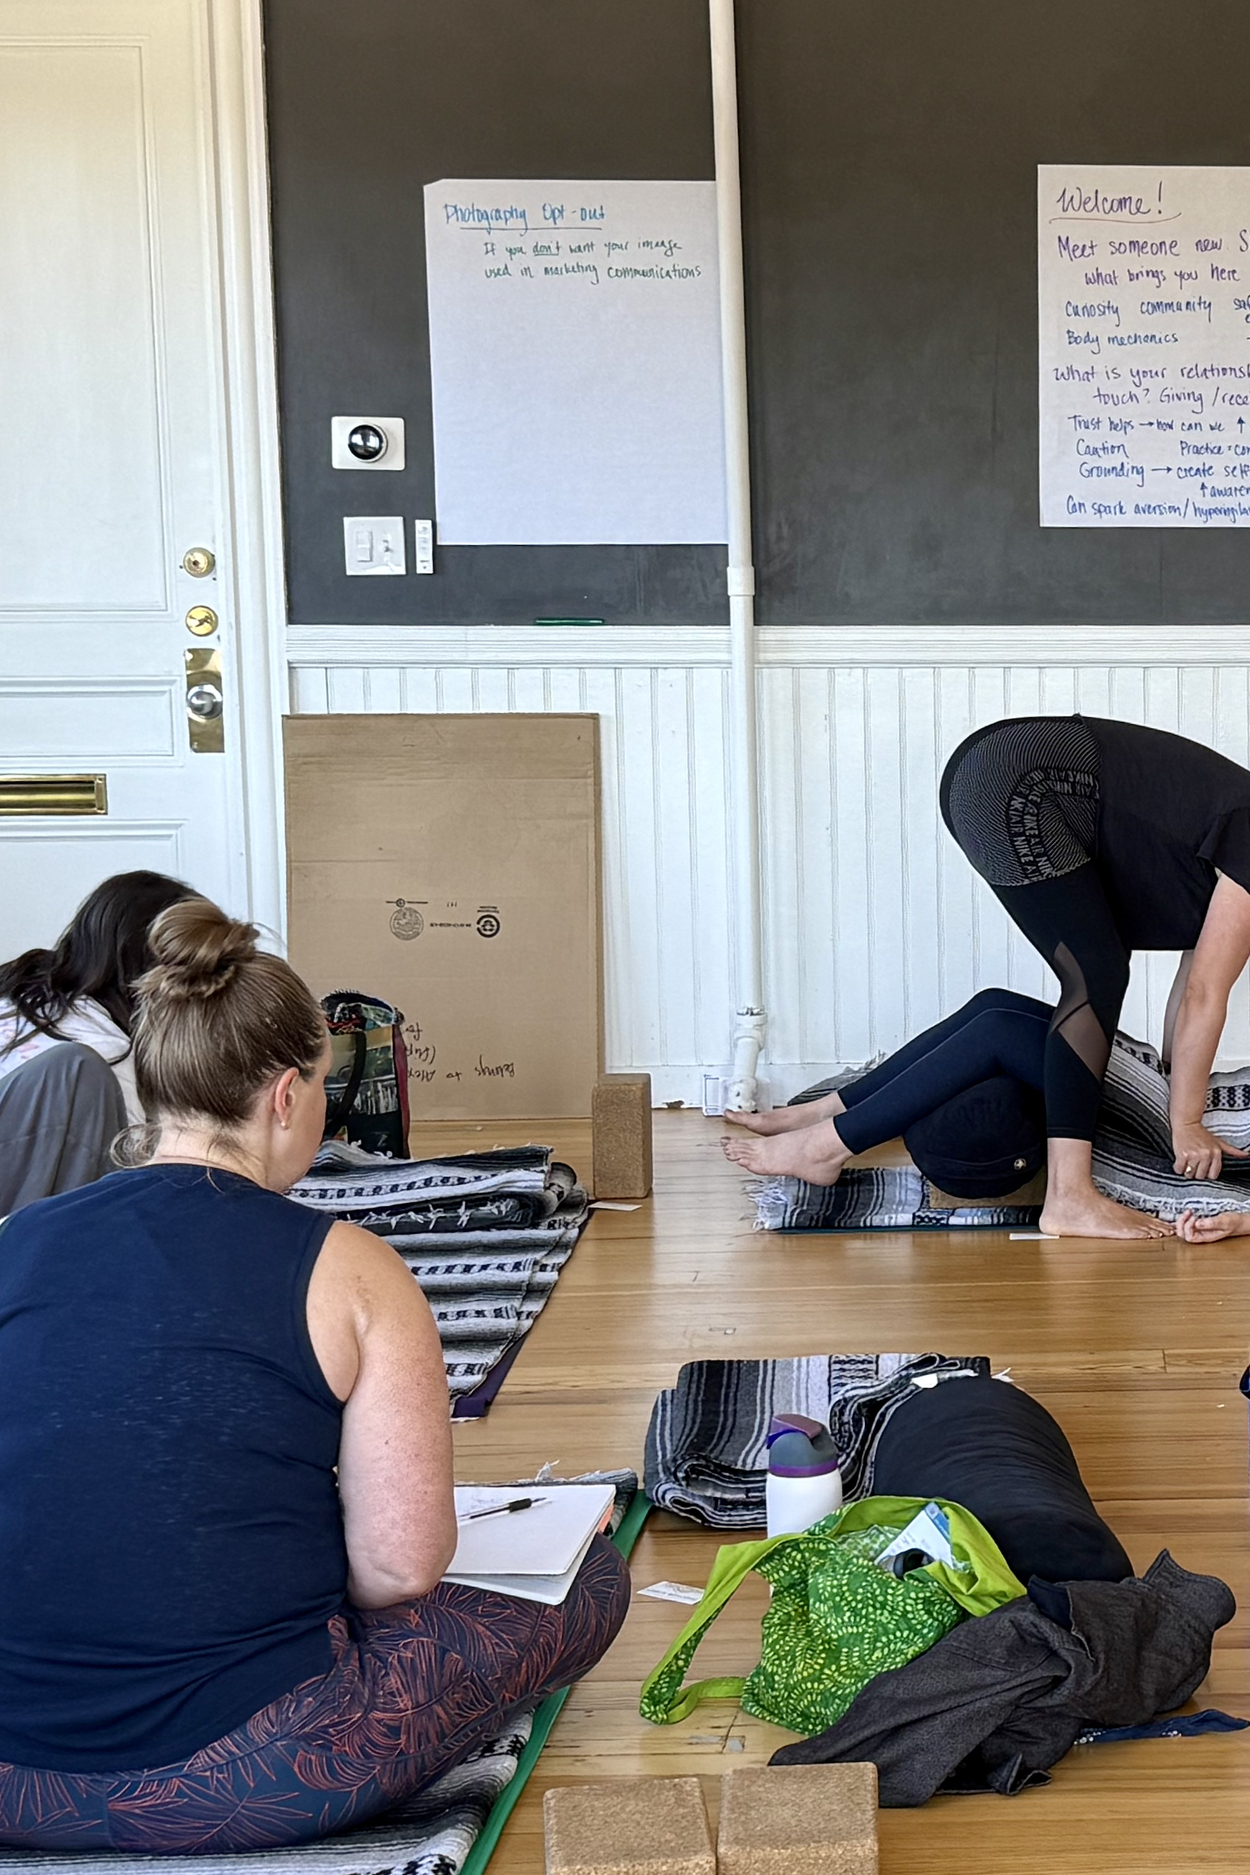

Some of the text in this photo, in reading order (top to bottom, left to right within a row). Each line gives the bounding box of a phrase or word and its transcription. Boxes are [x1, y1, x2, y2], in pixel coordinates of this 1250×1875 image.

[1056, 180, 1163, 215] Welcome!
[443, 203, 527, 236] Photography
[505, 246, 526, 261] you
[569, 241, 595, 254] want
[604, 241, 629, 258] your
[1057, 235, 1098, 262] Meet
[1109, 238, 1181, 257] someone
[484, 261, 702, 285] used in marketing communications
[1128, 265, 1166, 289] brings
[1174, 270, 1198, 290] you
[1210, 263, 1241, 281] here
[1065, 299, 1121, 327] Curiosity
[1140, 296, 1212, 322] community
[1066, 329, 1179, 355] Body mechanics
[1053, 364, 1098, 382] What
[1104, 366, 1121, 379] is
[1130, 367, 1168, 387] your
[1159, 386, 1205, 415] Giving
[1067, 414, 1102, 432] Trust
[1108, 416, 1135, 435] helps
[1180, 420, 1203, 432] can
[1075, 438, 1130, 459] Caution
[1179, 440, 1225, 456] Practice
[1079, 461, 1145, 487] Grounding
[1176, 462, 1214, 479] create
[1224, 463, 1250, 479] self
[1066, 494, 1086, 515] Can
[1092, 500, 1126, 518] spark
[1012, 836, 1034, 863] NIKE
[446, 1071, 462, 1081] to
